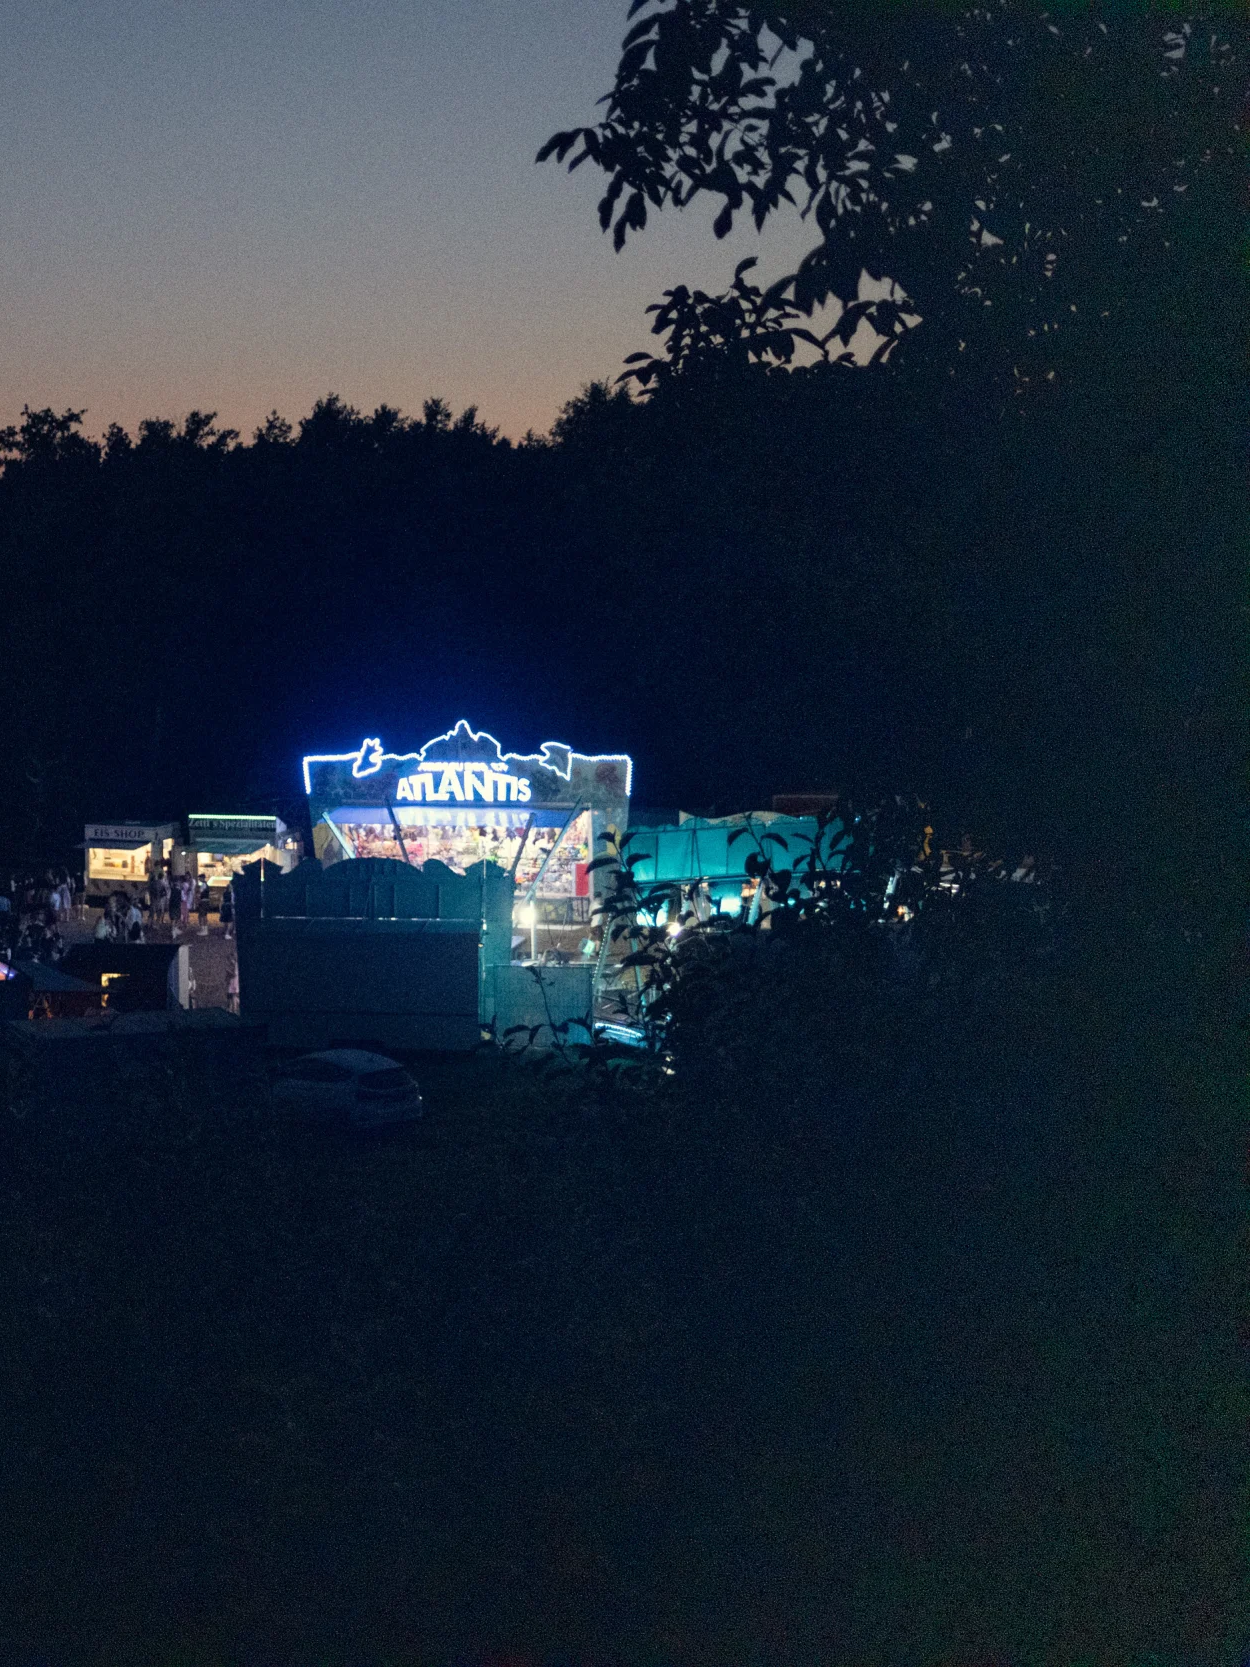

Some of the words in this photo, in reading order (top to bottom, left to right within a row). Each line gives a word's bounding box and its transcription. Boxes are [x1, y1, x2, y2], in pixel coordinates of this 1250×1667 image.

[396, 768, 532, 802] ATLANTIS
[94, 828, 110, 837] EIS
[114, 829, 145, 838] SHOP
